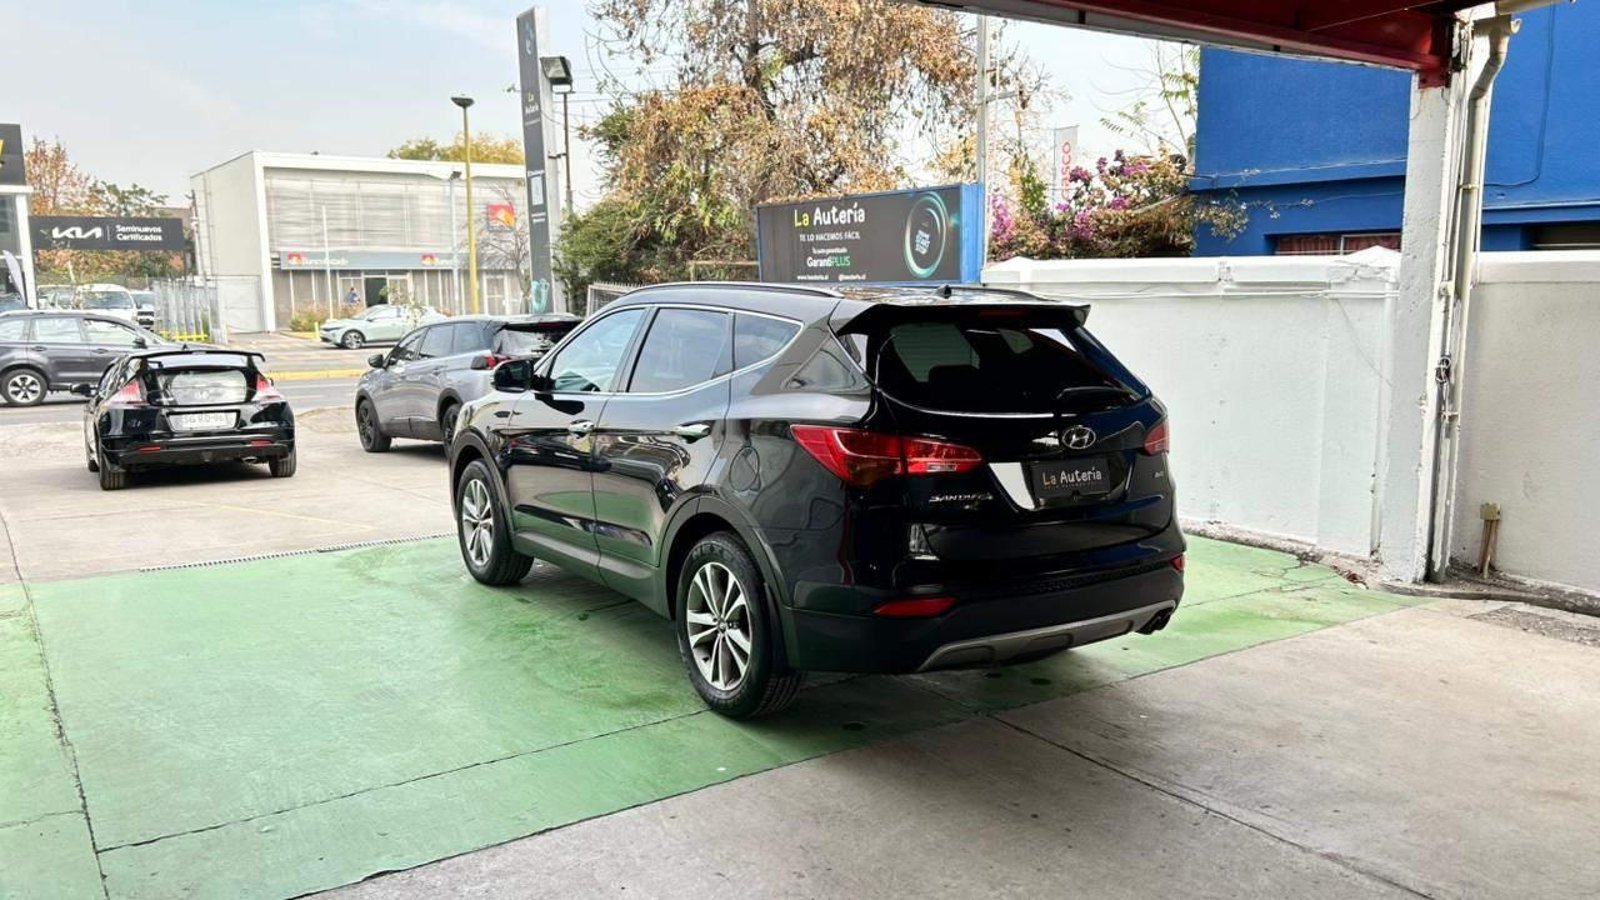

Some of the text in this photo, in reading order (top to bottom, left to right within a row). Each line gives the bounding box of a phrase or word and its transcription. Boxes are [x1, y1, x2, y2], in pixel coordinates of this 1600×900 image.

[794, 202, 866, 228] La Autería
[115, 224, 163, 233] Seminuevos
[116, 233, 163, 241] Certificados
[807, 233, 814, 241] LO
[815, 231, 843, 241] HACEMOS
[1042, 472, 1057, 486] La
